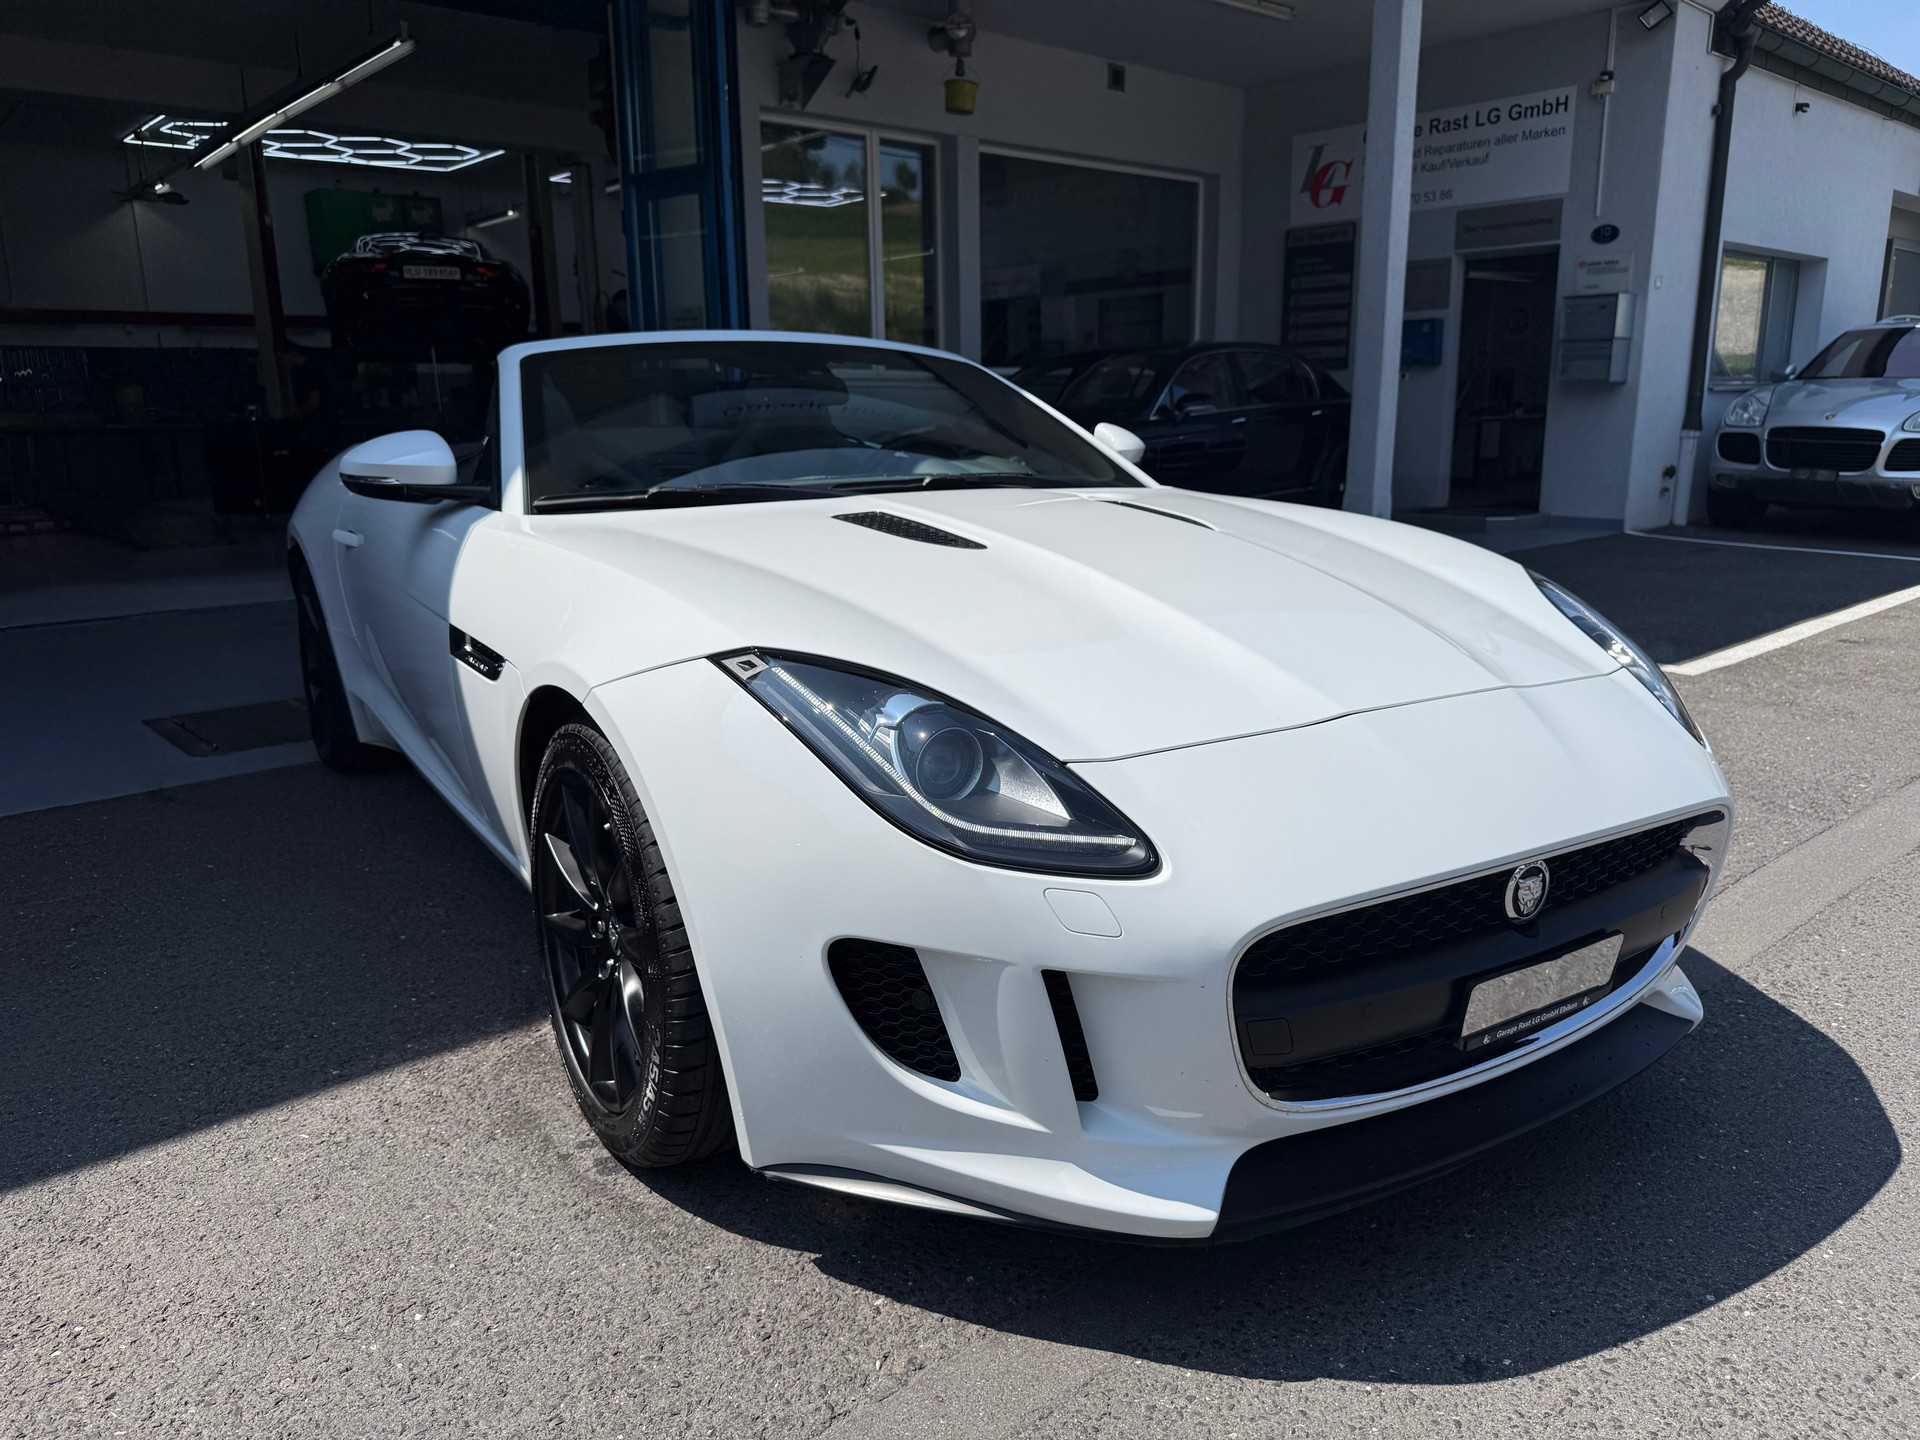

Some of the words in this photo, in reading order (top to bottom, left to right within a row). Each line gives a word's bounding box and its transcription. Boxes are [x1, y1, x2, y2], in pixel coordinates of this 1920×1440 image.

[1429, 114, 1469, 135] Rast
[1475, 107, 1501, 127] LG
[1508, 95, 1569, 121] GmbH
[1424, 137, 1491, 158] Reparaturen
[1494, 132, 1517, 147] aller
[1521, 126, 1565, 142] Marken
[1420, 153, 1489, 174] Kauf/Verkauf
[1423, 191, 1438, 202] 53
[1497, 1025, 1517, 1037] Garage
[1518, 1019, 1531, 1029] Rast
[1532, 1015, 1540, 1024] LG
[1541, 1008, 1559, 1020] GmbH
